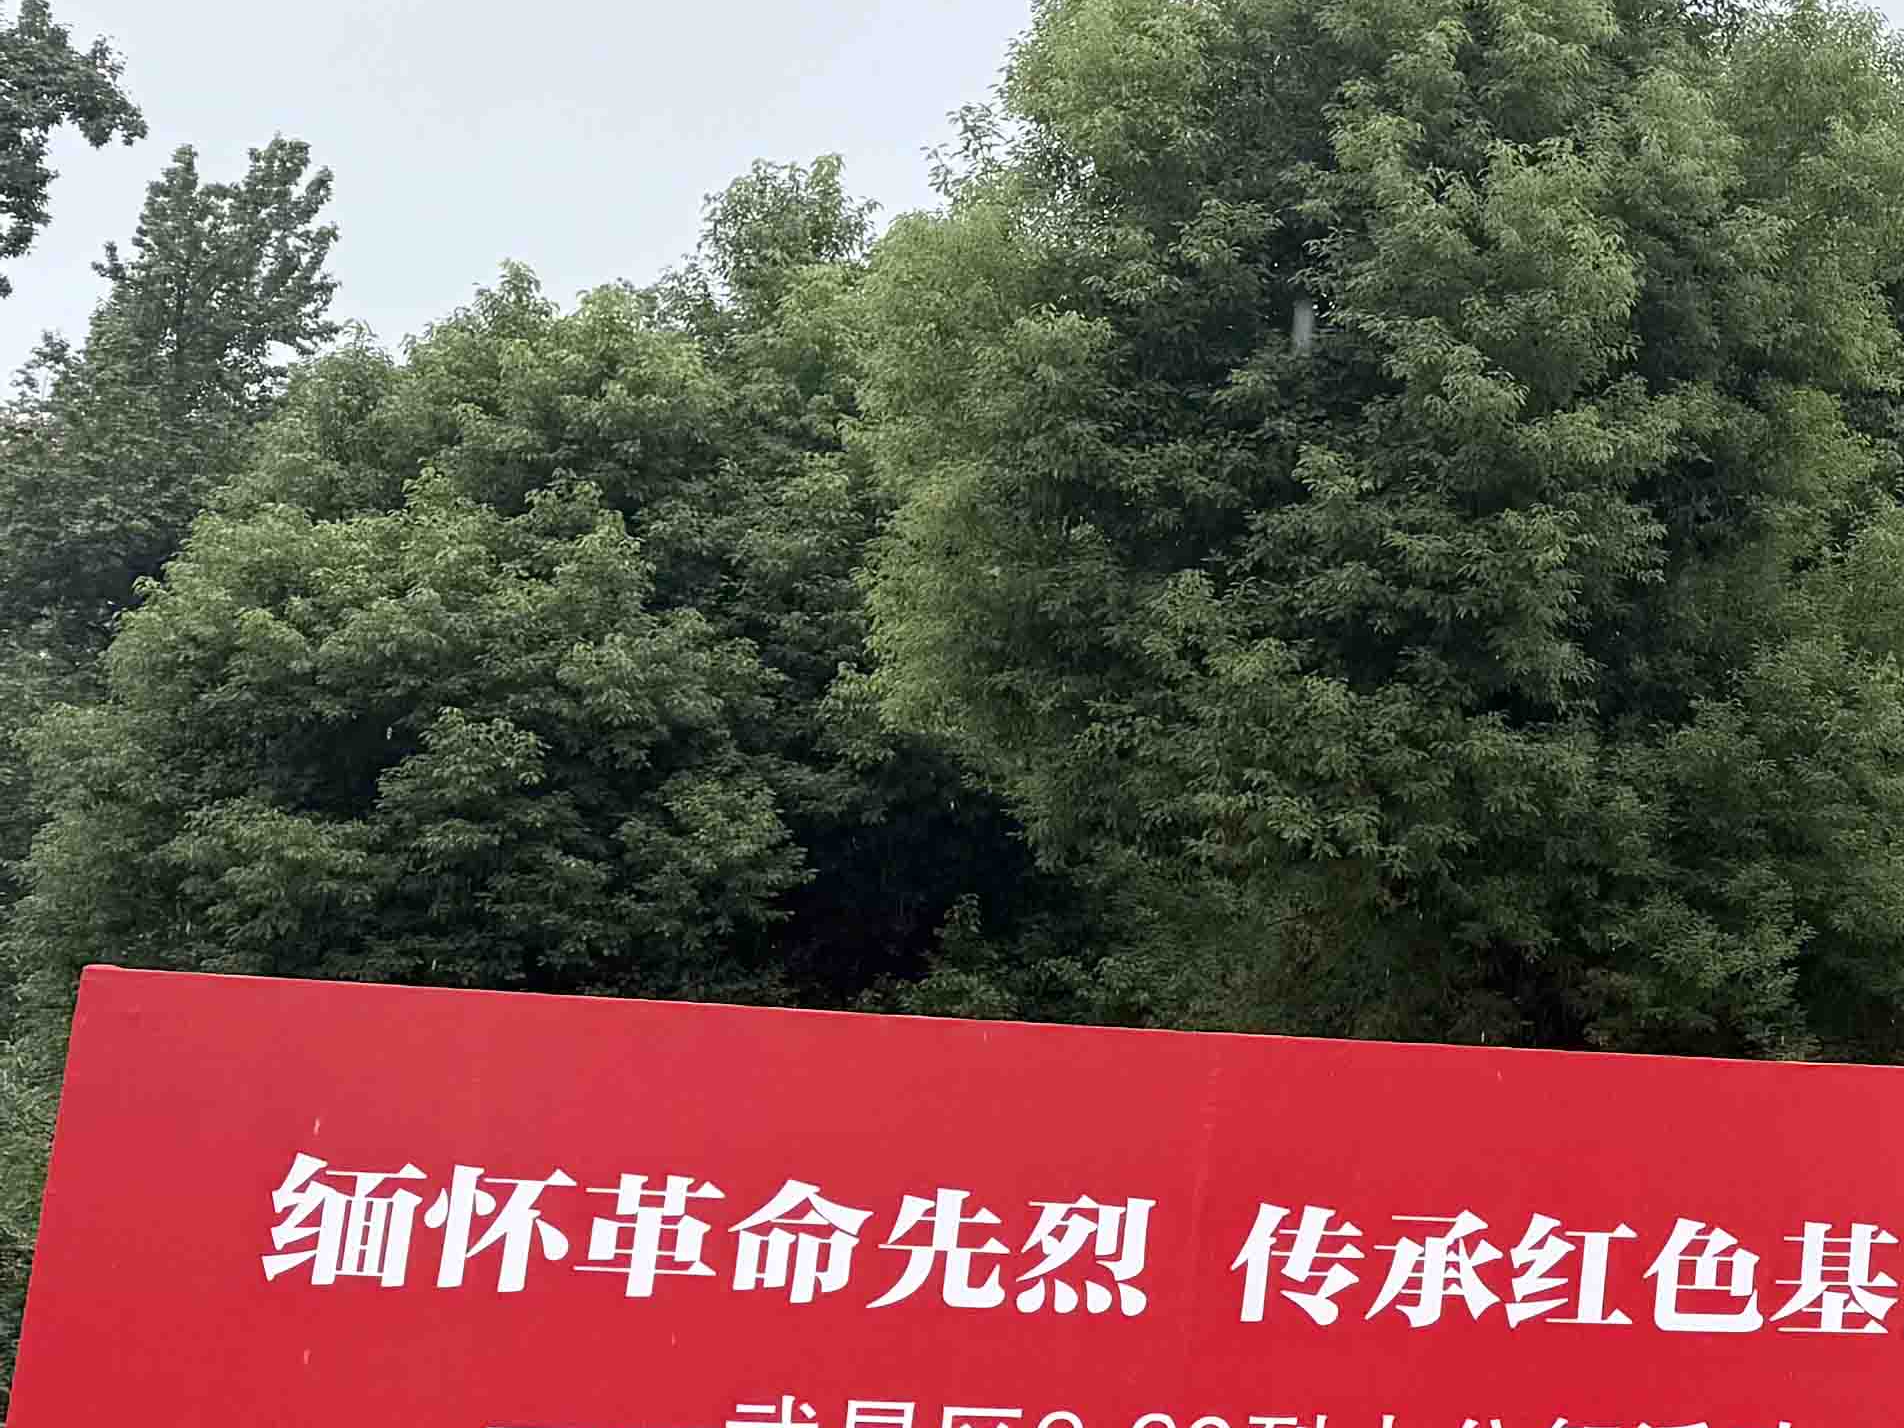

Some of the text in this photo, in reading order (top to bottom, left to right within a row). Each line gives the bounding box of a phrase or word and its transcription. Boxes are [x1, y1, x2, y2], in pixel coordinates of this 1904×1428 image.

[260, 1152, 1159, 1317] 缅怀革命先烈
